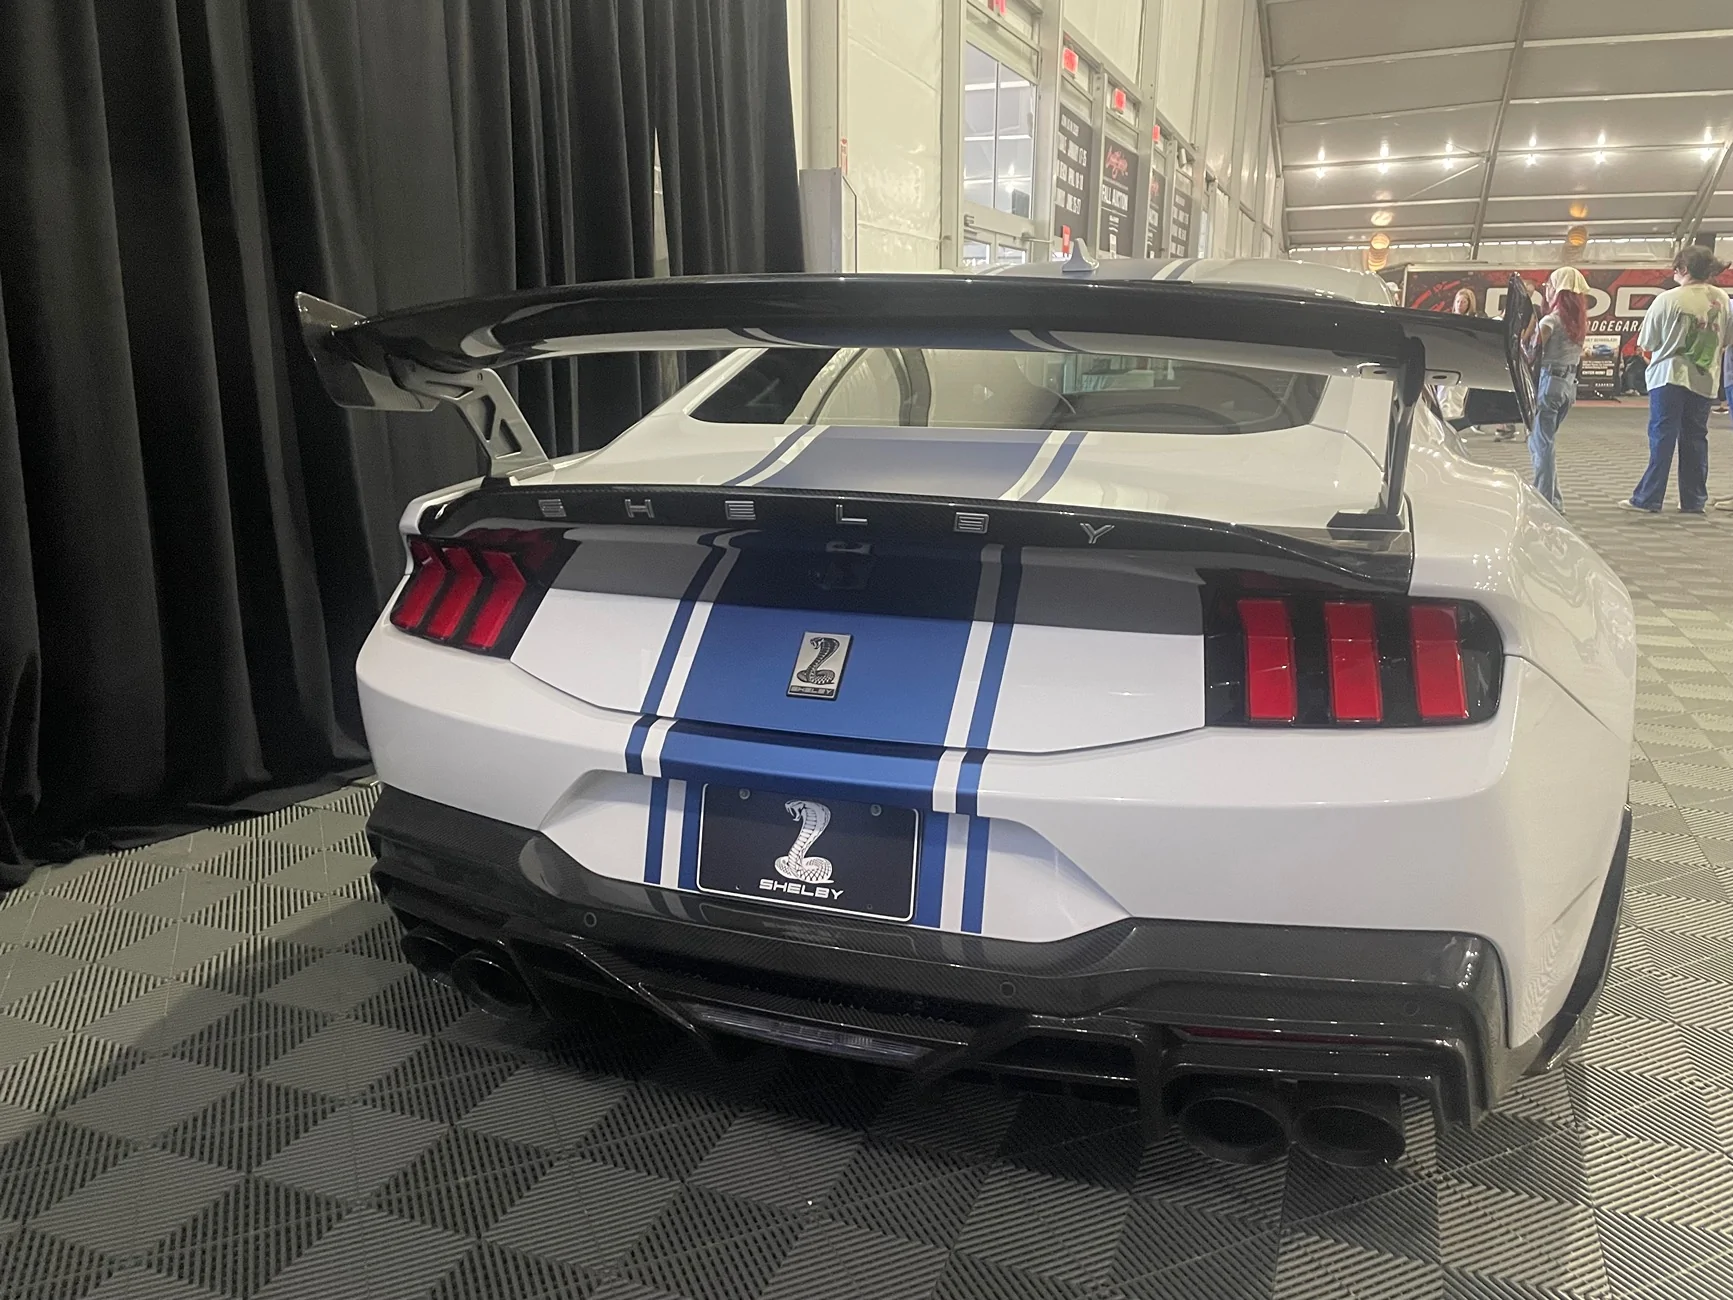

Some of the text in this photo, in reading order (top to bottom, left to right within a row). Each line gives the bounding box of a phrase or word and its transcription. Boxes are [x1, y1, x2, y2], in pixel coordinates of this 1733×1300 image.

[538, 498, 1115, 544] SHELBY
[789, 685, 834, 696] SHELBY
[759, 878, 844, 900] SHELBY
